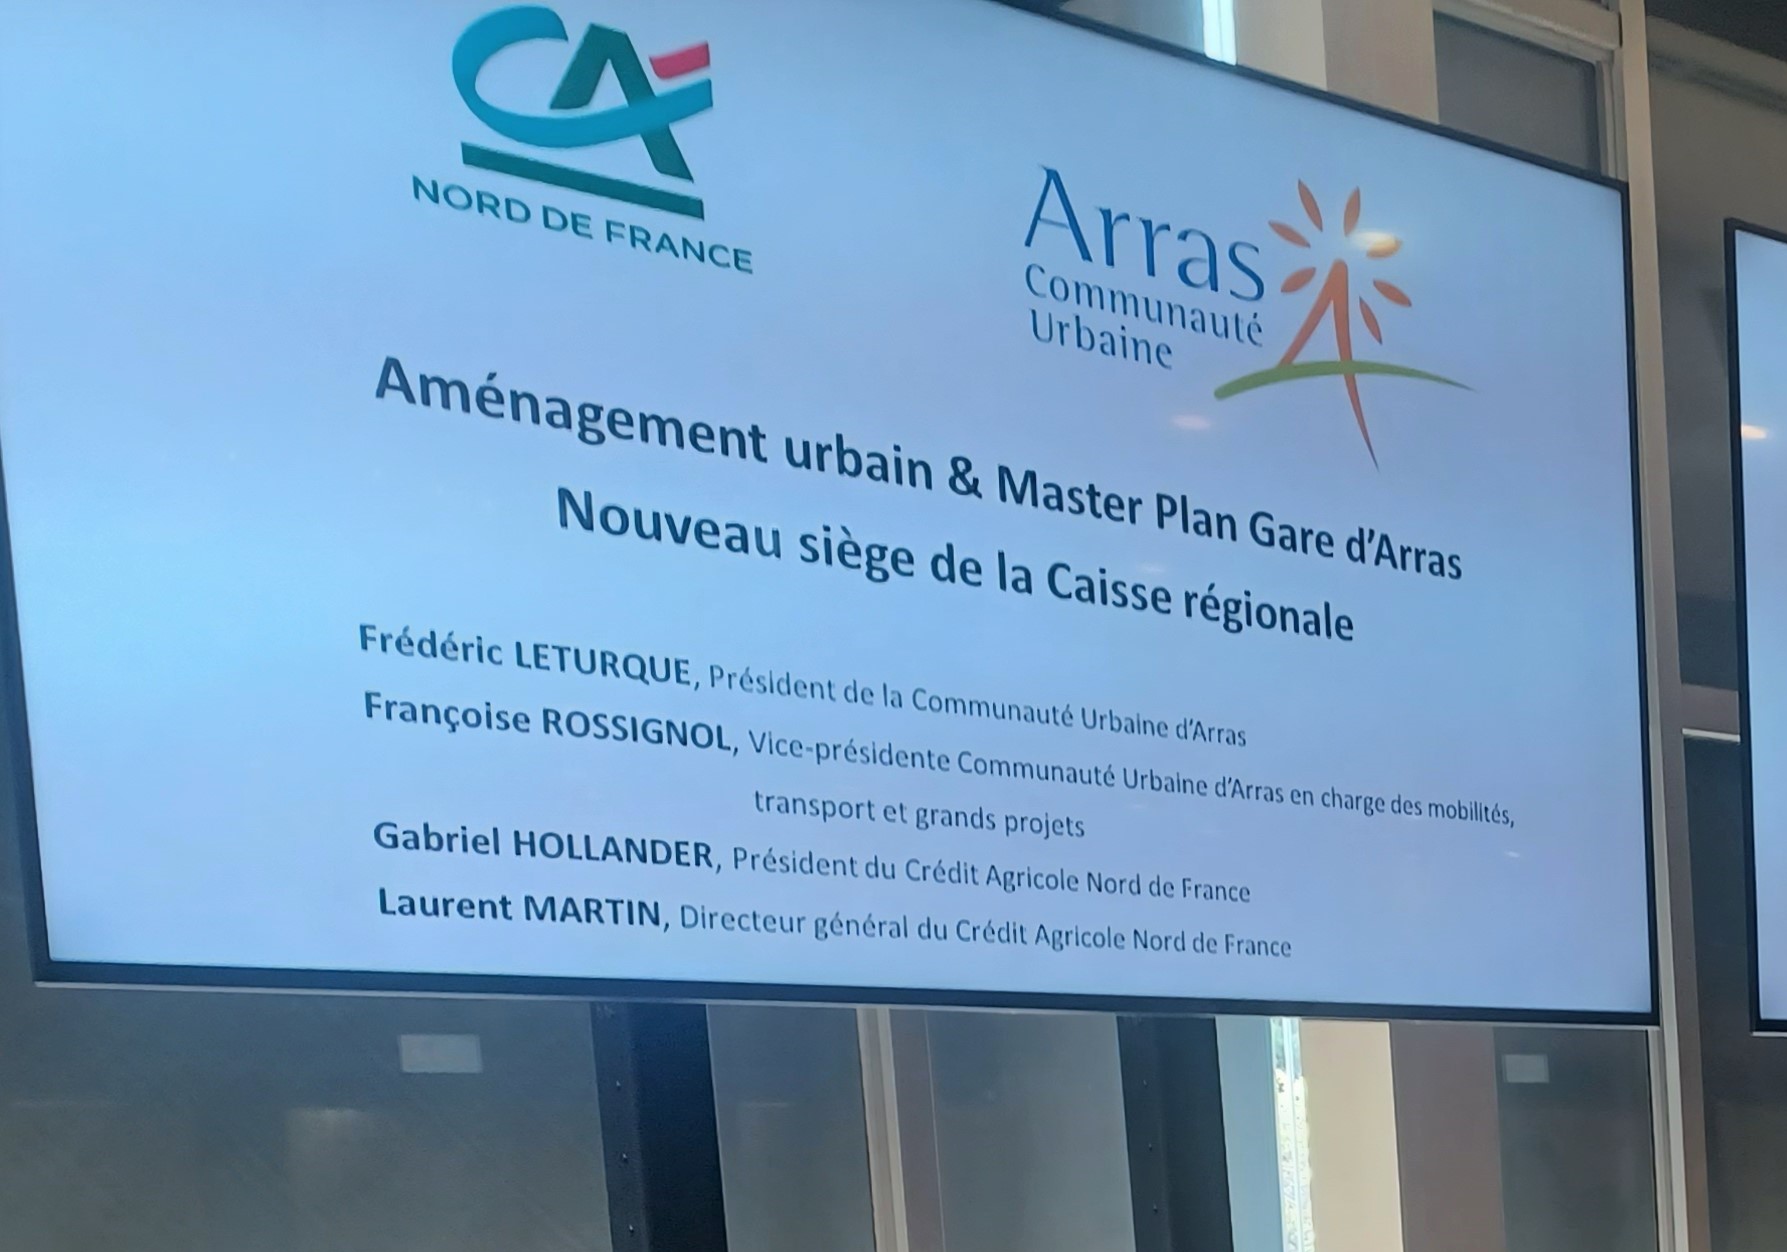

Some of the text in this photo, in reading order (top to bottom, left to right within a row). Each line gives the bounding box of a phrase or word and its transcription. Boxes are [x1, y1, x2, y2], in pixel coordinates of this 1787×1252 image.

[412, 175, 753, 275] NORD DE FRANCE
[1025, 164, 1265, 301] Arras
[1025, 263, 1264, 348] Communauté
[1030, 308, 1173, 370] Urbaine
[375, 356, 1462, 580] Aménagement urbain & Master Plan Gare d'Arras
[557, 487, 1354, 642] Nouveau siège de la Caisse régionale
[359, 624, 1247, 747] Frédéric LETURQUE, Président de la Communauté Urbaine d'Arras
[364, 691, 1515, 829] Françoise ROSSIGNOL, Vice-présidente Communauté Urbaine d'Arras en charge des mobilités,
[373, 821, 1251, 903] Gabriel HOLLANDER, Président du Crédit Agricole Nord de France
[755, 790, 1085, 840] transport et grands projets
[379, 887, 1292, 957] Laurent MARTIN, Directeur général du Crédit Agricole Nord de France
